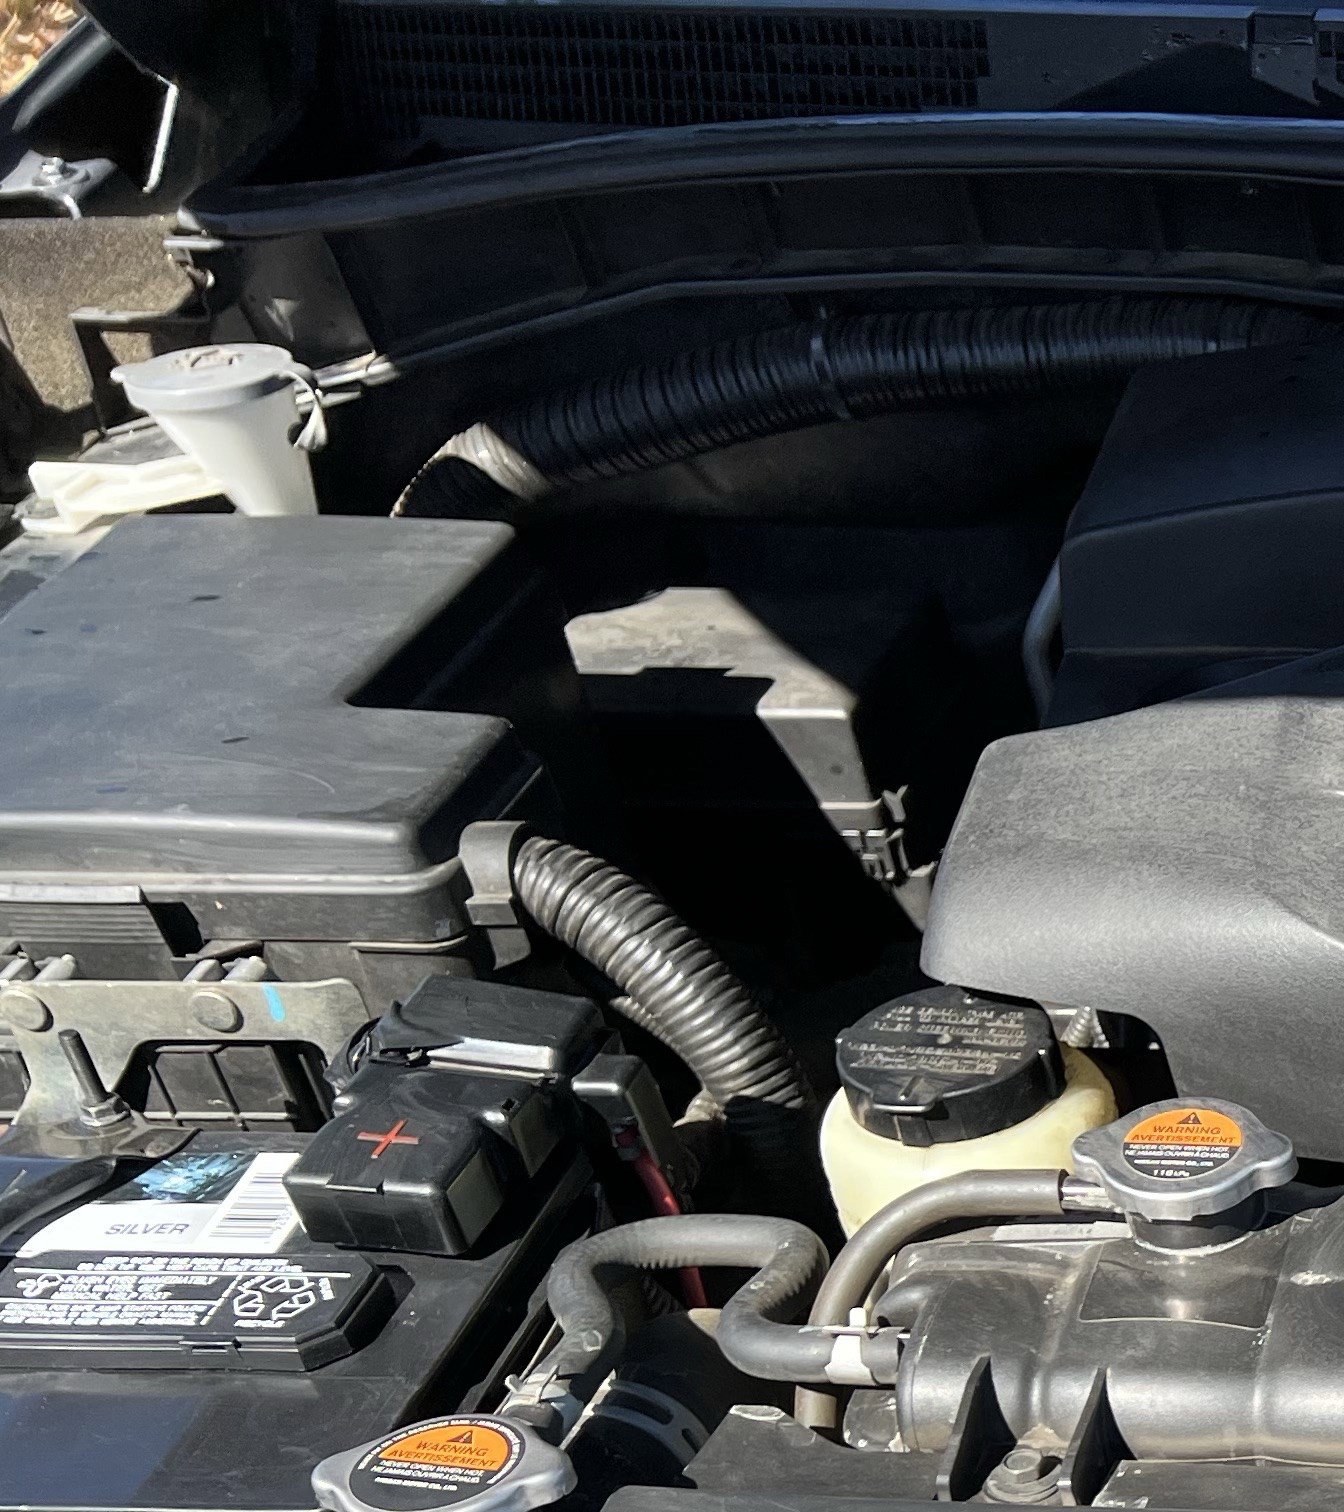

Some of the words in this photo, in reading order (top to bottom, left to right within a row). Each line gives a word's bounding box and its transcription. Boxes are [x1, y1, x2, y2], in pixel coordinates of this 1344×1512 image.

[1152, 1125, 1221, 1135] WARNING
[1131, 1134, 1236, 1143] AVERTISSEMENT
[104, 1222, 190, 1235] SILVER
[64, 1275, 105, 1284] FLUSH
[105, 1275, 139, 1284] EYES
[138, 1275, 219, 1285] IMMEDIATELY
[59, 1284, 92, 1292] WITH
[137, 1284, 167, 1293] GET
[50, 1292, 102, 1300] MEDICAL
[104, 1292, 139, 1300] HELP
[137, 1292, 173, 1300] FAST
[416, 1440, 489, 1457] WARNING
[388, 1449, 498, 1468] AVERTISSEMENT
[380, 1460, 410, 1469] NEVER
[410, 1463, 436, 1472] OPEN
